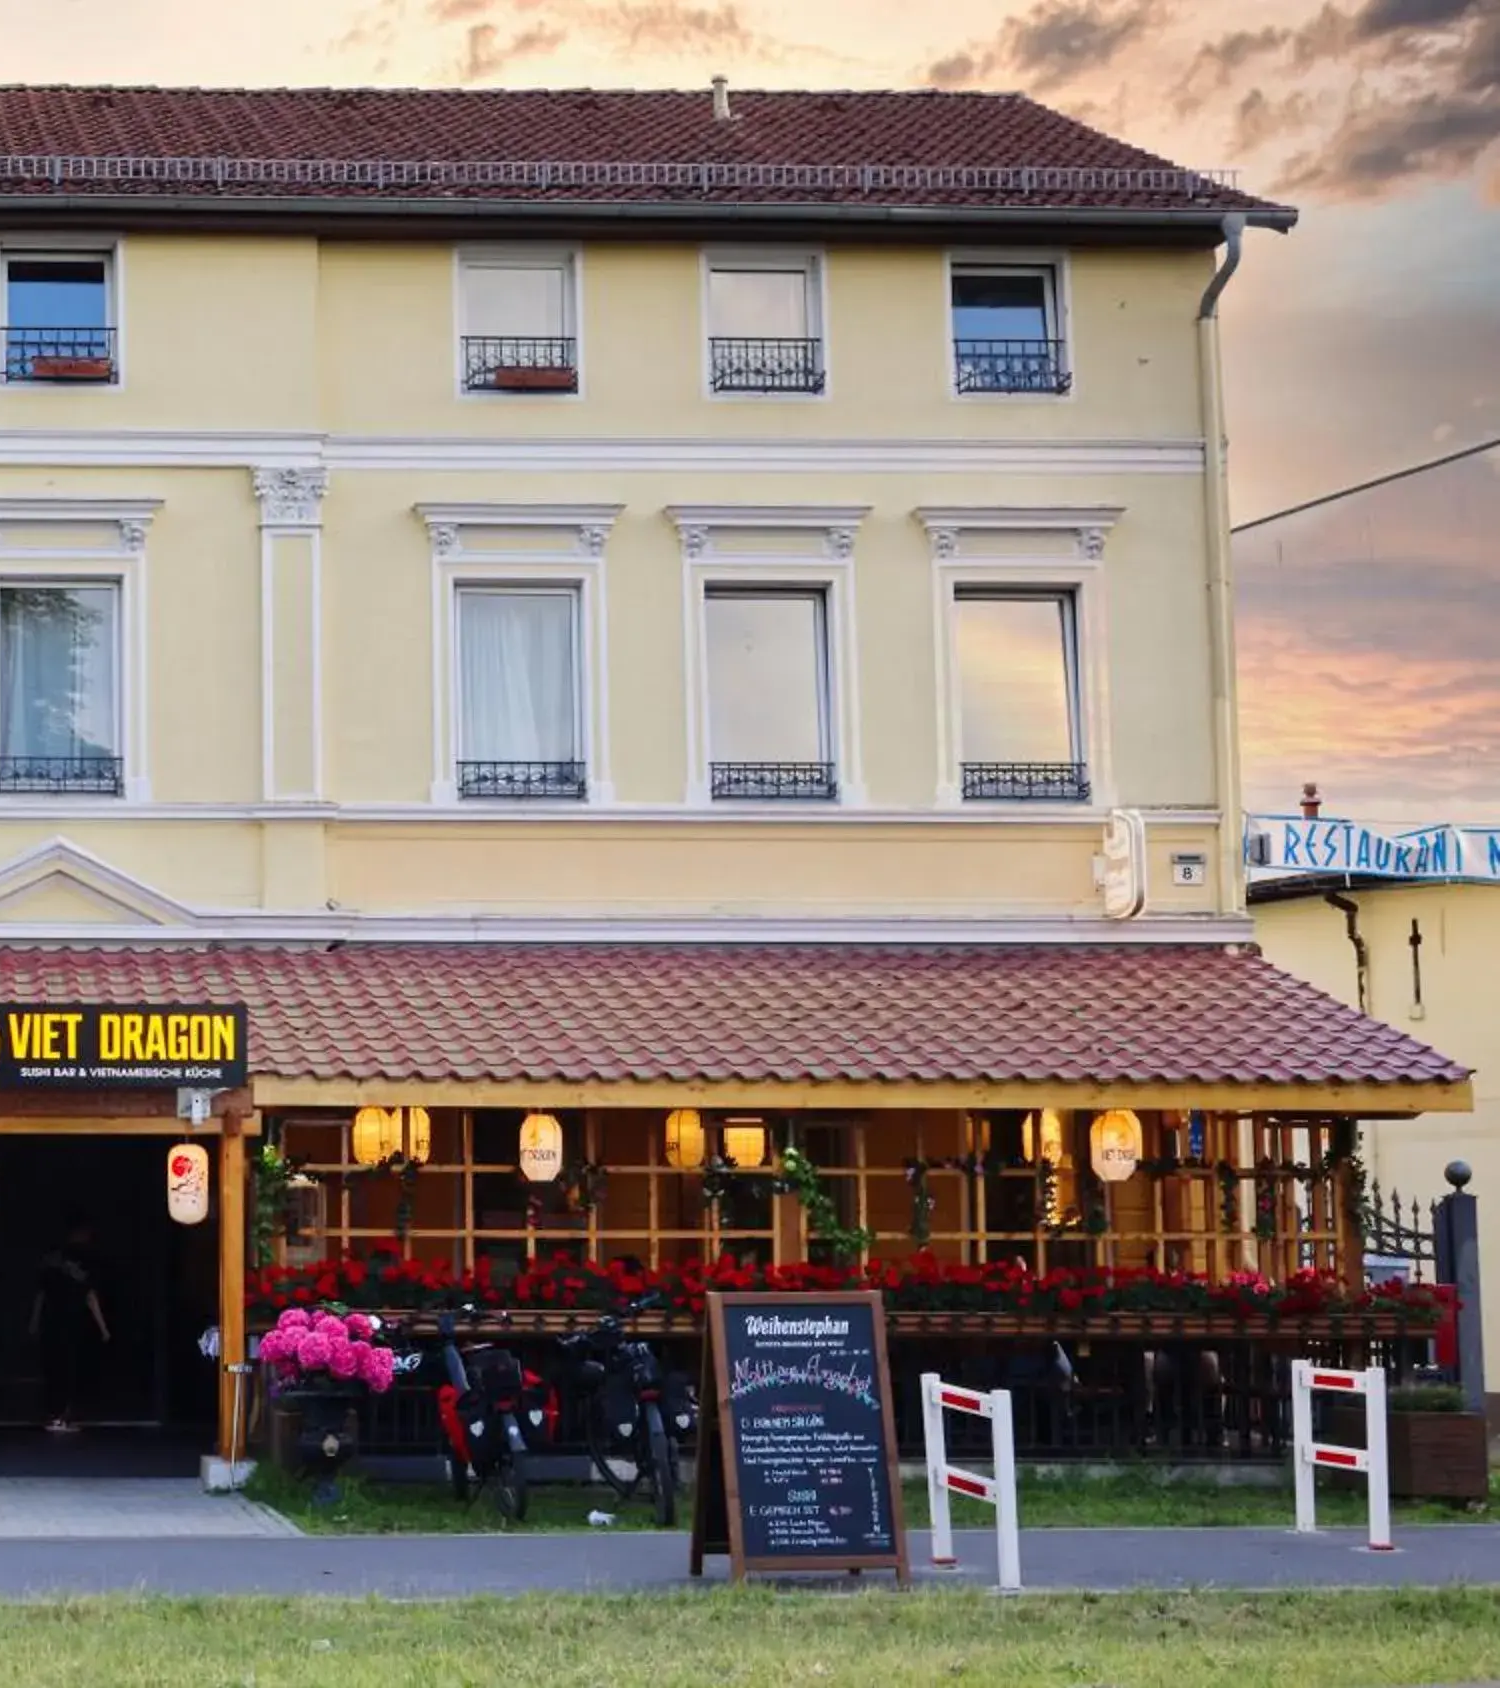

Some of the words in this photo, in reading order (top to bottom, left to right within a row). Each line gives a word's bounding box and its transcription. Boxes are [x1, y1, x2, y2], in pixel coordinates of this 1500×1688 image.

[8, 1013, 83, 1059] VIET
[100, 1014, 235, 1061] DRAGON
[20, 1067, 51, 1078] SUSHI
[53, 1067, 76, 1078] BAR
[78, 1068, 87, 1078] &
[90, 1067, 182, 1079] VIETNAMESISCHE
[185, 1066, 222, 1079] KÜCHE
[745, 1315, 849, 1338] Weihenstephan
